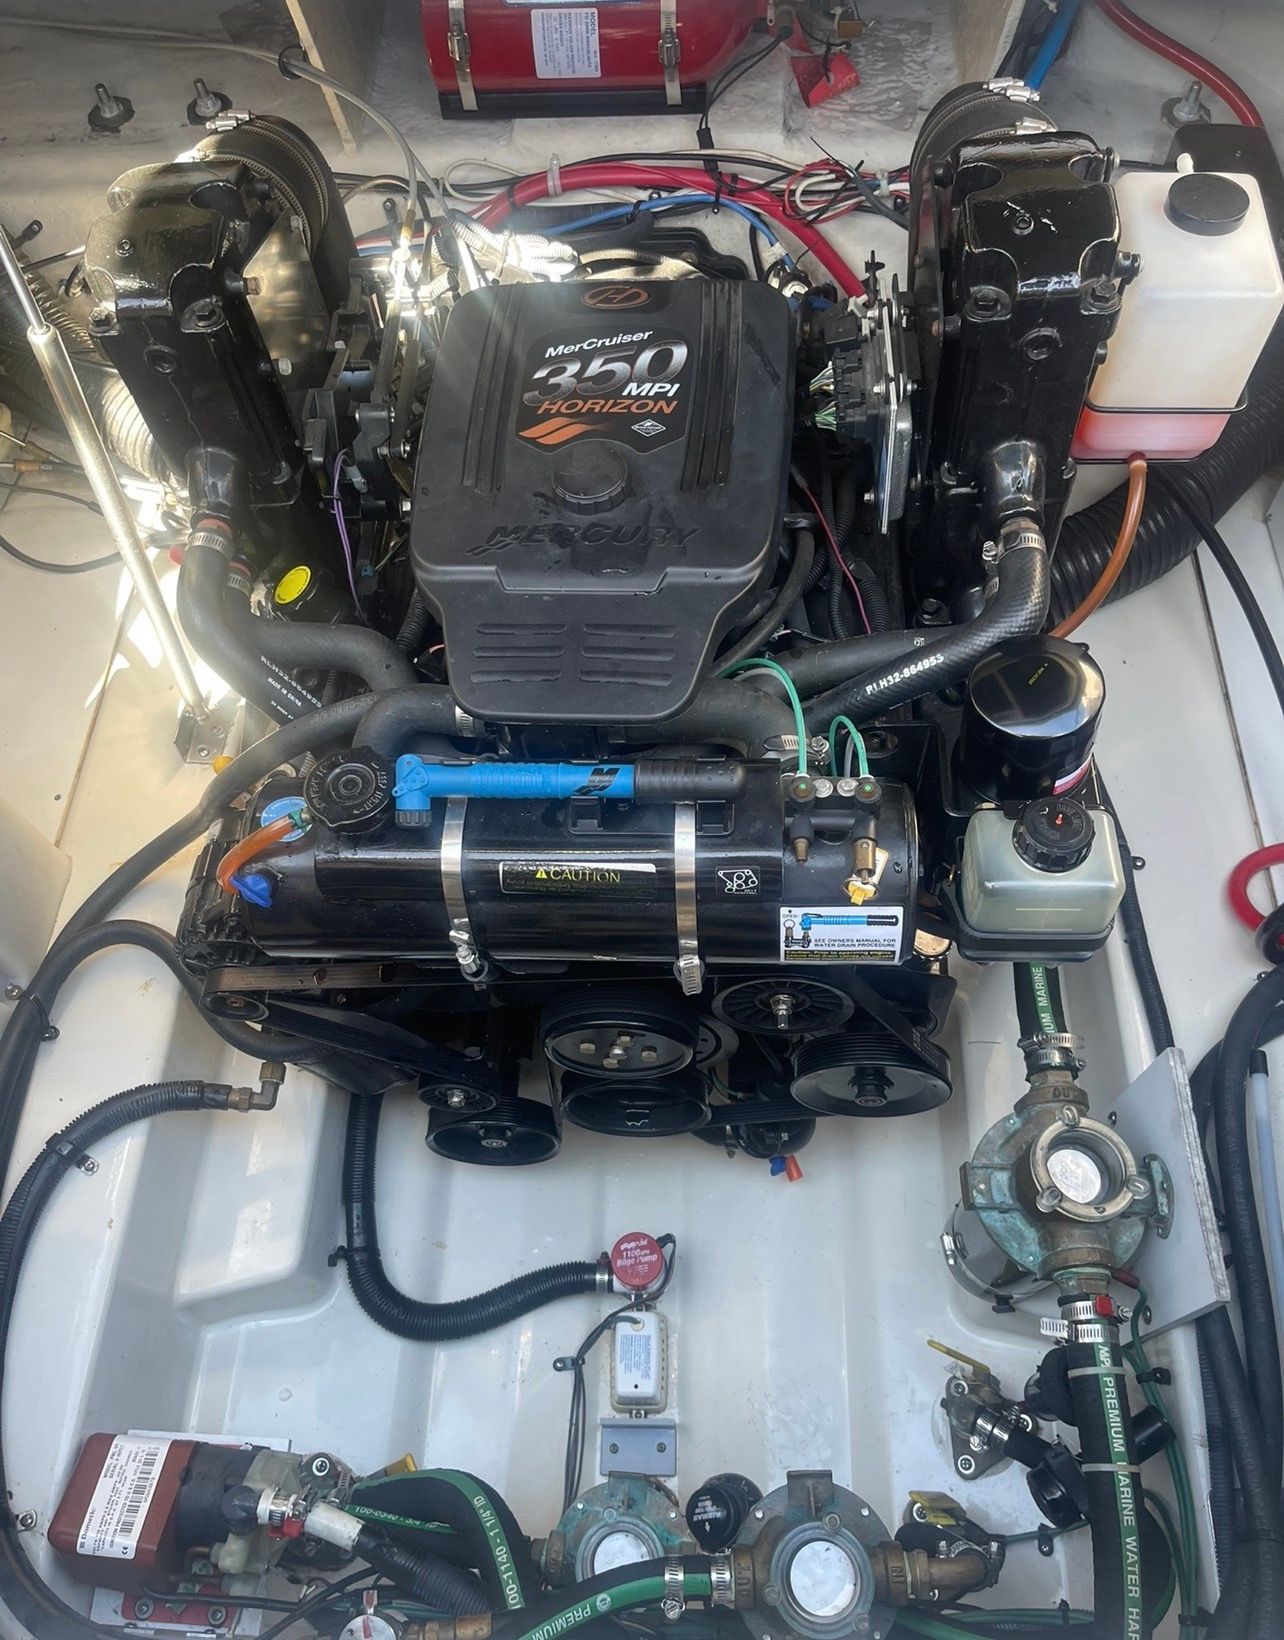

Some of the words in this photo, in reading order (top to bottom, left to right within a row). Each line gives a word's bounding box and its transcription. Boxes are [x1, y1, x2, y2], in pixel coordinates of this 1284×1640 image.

[545, 329, 653, 358] MerCruiser
[523, 339, 689, 407] 350
[622, 383, 681, 398] MPI
[537, 399, 678, 415] HORIZON
[484, 523, 701, 549] MERCURY
[550, 866, 621, 883] CAUTION
[1032, 966, 1049, 1006] MARINE
[623, 1249, 640, 1258] 1100
[473, 1495, 487, 1508] ID
[1103, 1377, 1125, 1452] PREMIUM
[1125, 1536, 1140, 1598] WATER
[81, 1507, 96, 1540] Dometic
[495, 1545, 522, 1610] 100-1140
[532, 1606, 591, 1640] PREMIUM
